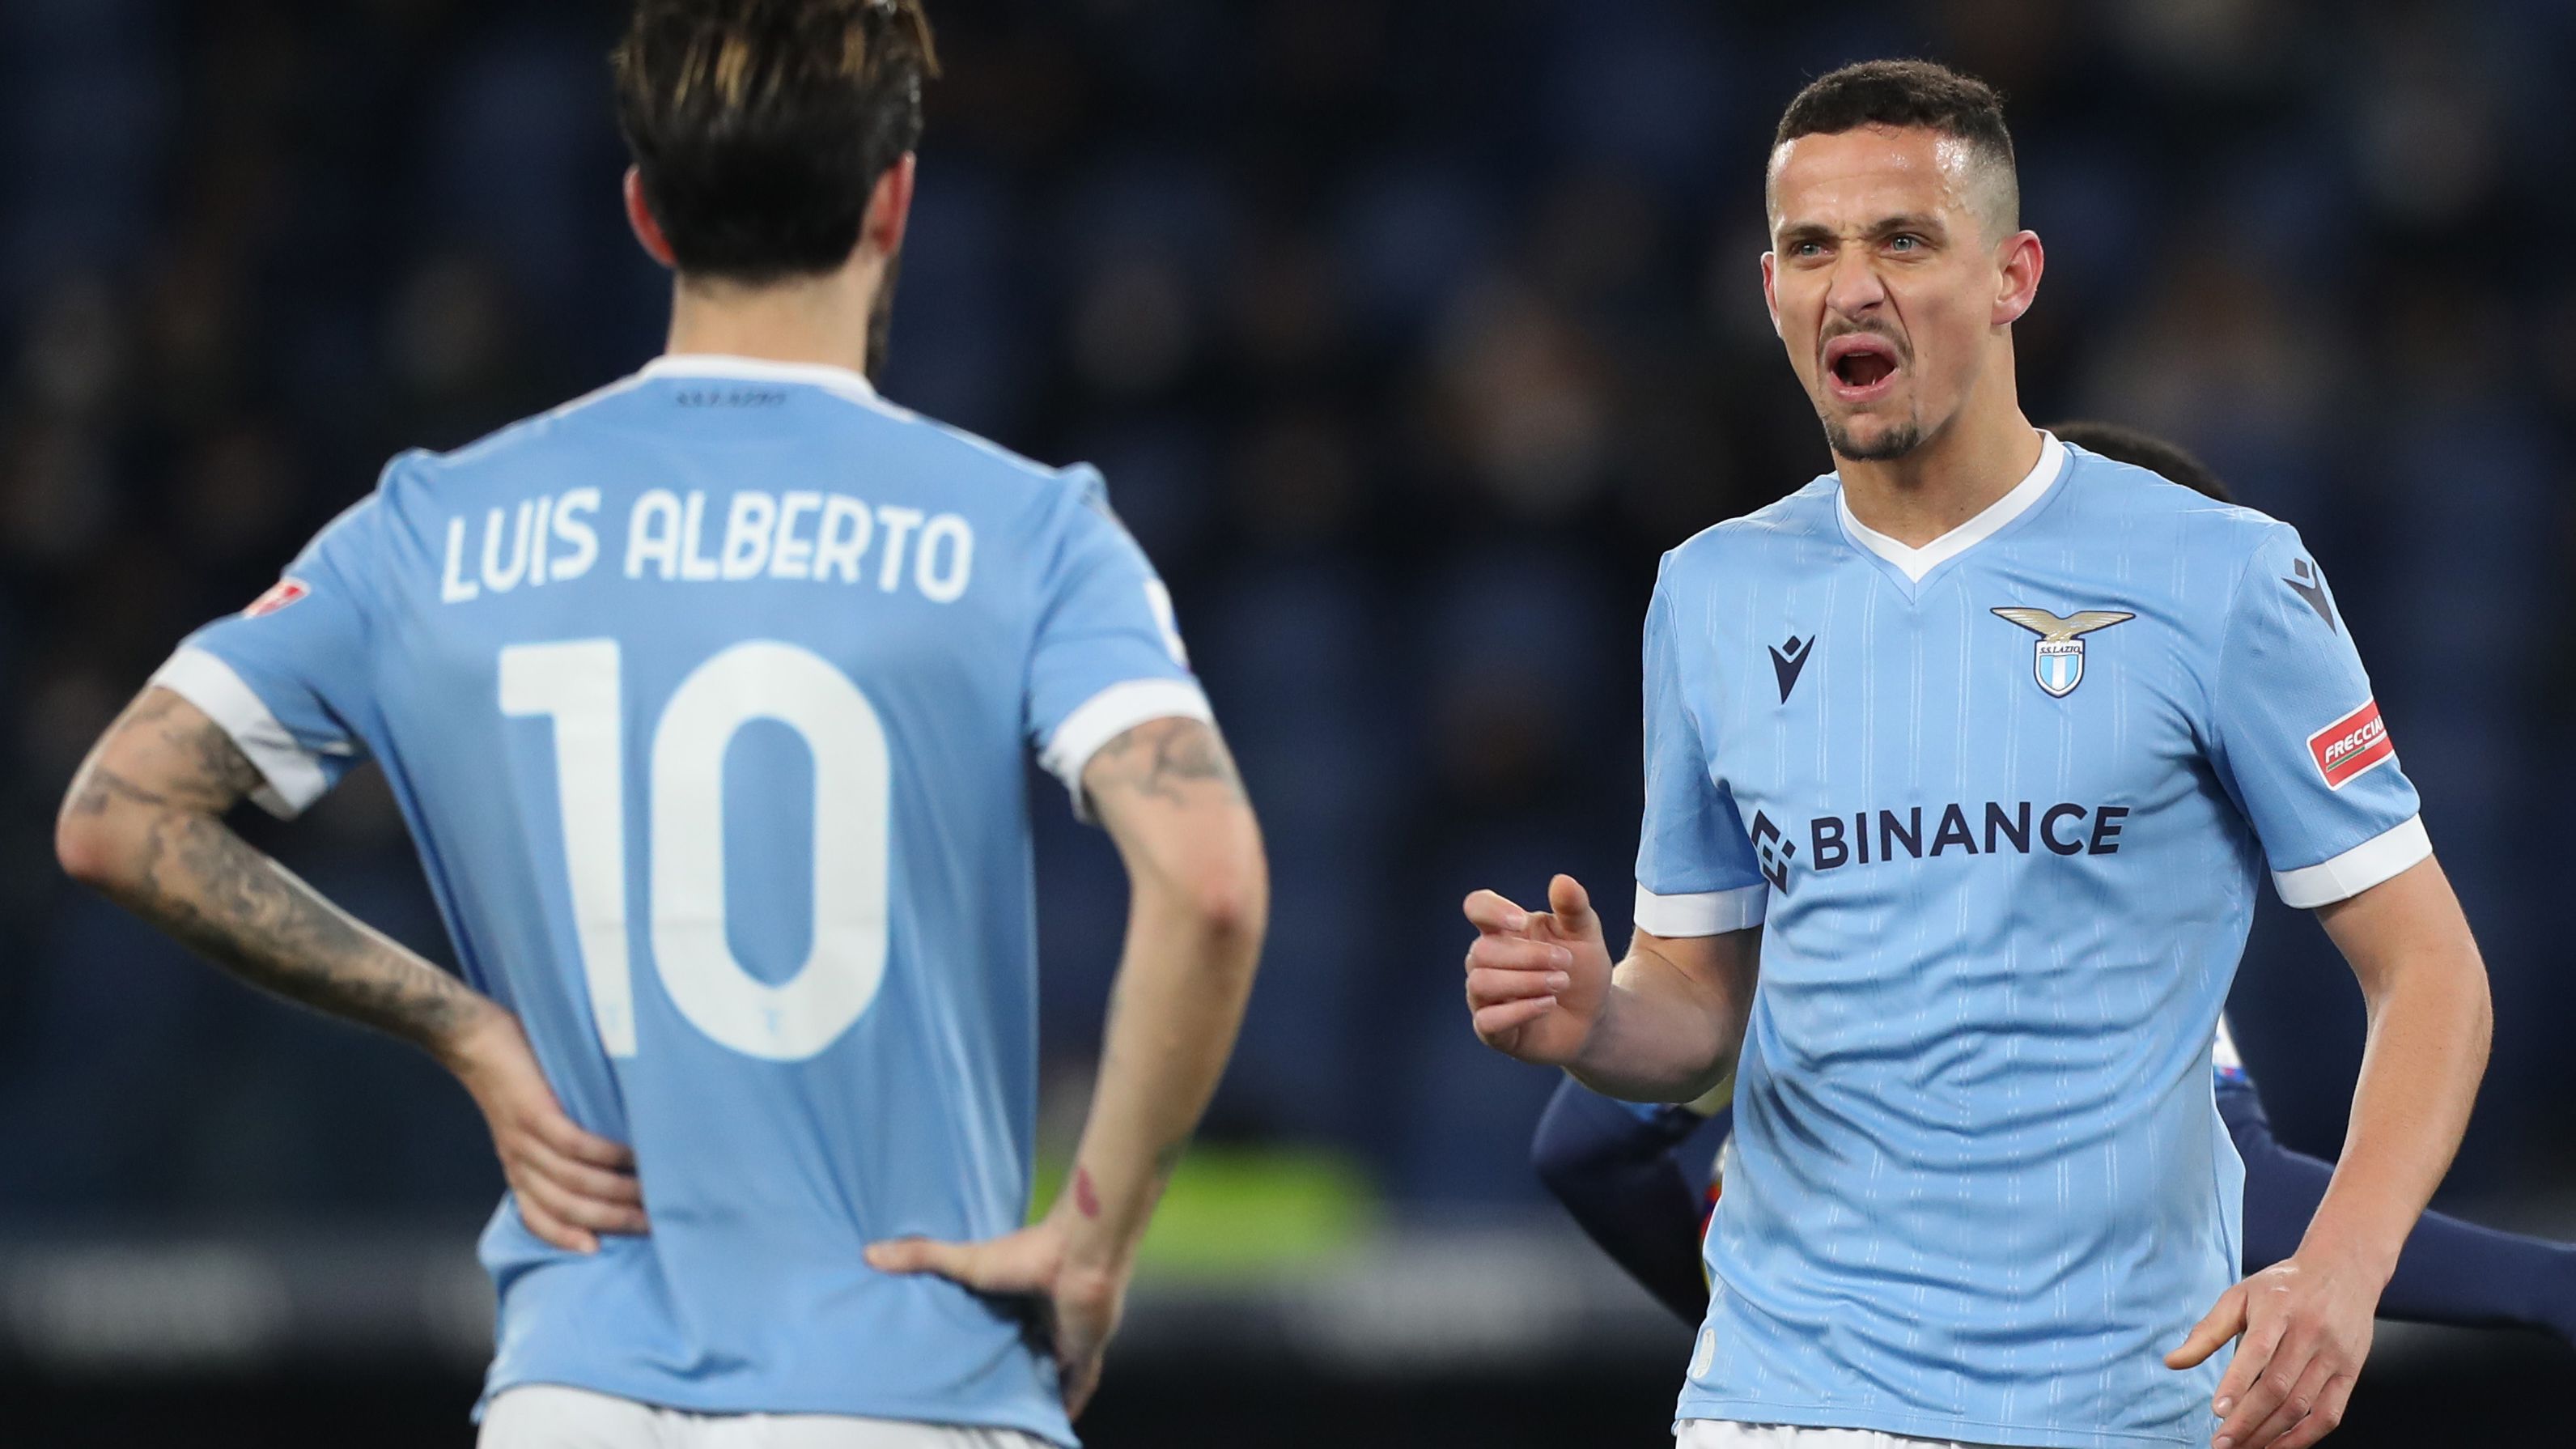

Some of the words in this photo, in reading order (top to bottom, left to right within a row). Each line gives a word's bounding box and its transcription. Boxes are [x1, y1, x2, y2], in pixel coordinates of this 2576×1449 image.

[442, 487, 601, 603] LUIS
[625, 489, 973, 603] ALBERTO
[499, 639, 889, 1061] 10
[1811, 801, 2129, 870] BINANCE
